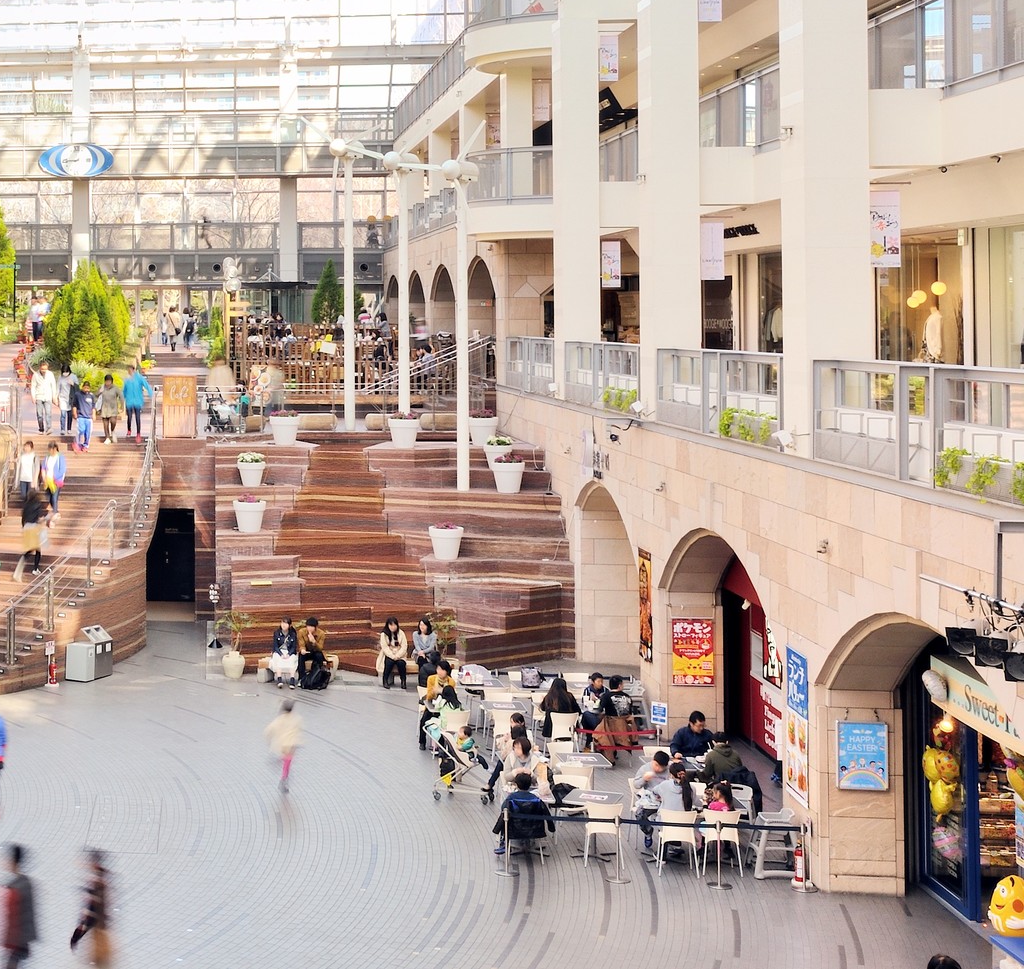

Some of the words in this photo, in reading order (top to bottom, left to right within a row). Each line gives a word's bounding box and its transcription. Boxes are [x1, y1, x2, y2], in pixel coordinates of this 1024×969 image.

[673, 622, 712, 634] ポケモン
[787, 659, 805, 685] ランチ
[964, 684, 1000, 727] Sweet
[849, 735, 876, 743] HAPPY
